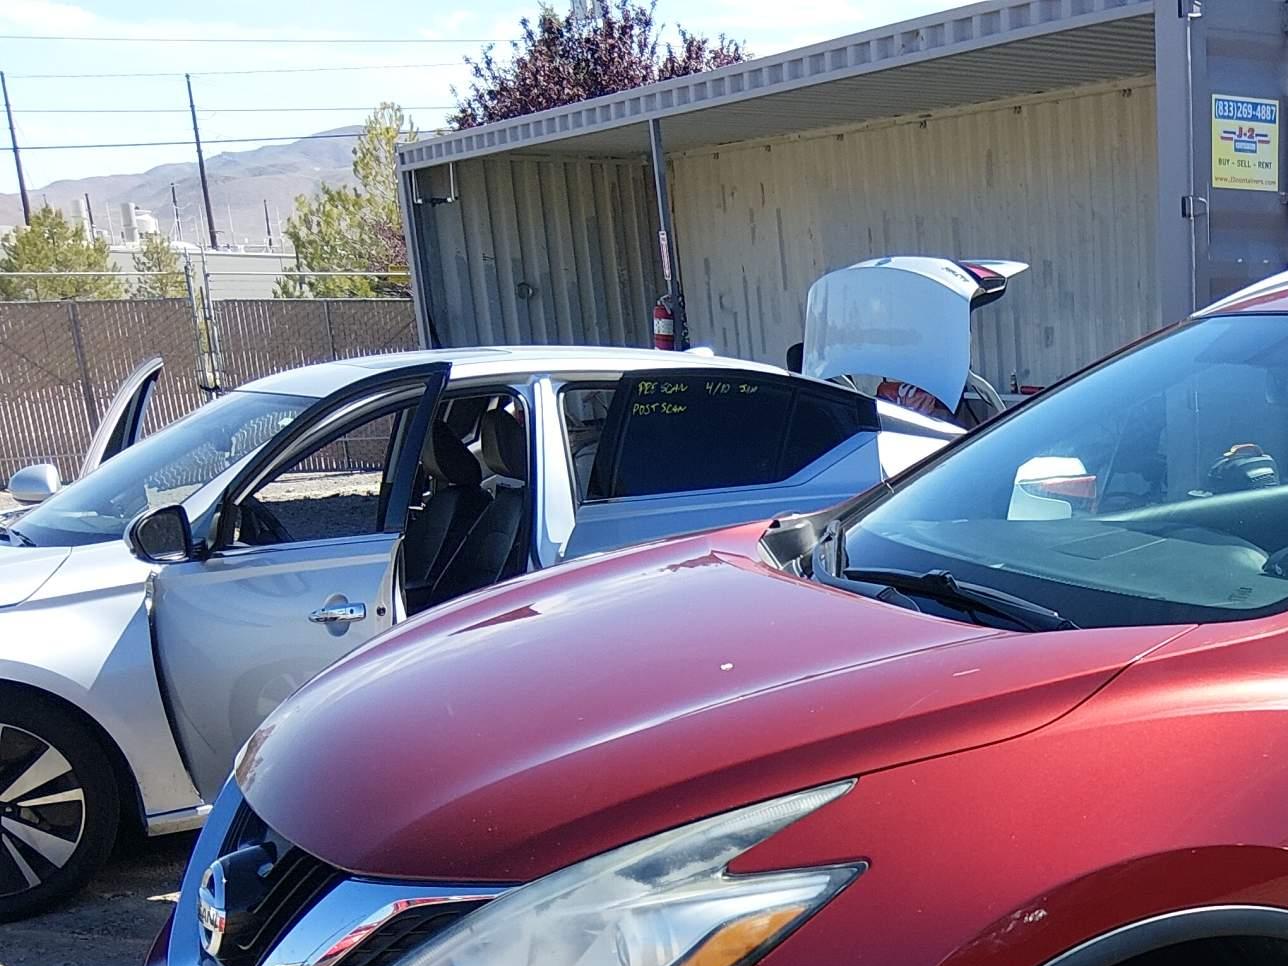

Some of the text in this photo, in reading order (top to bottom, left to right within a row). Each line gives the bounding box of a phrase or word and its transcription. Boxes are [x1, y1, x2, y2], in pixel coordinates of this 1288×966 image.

[1215, 101, 1276, 120] (833)269-4887
[1218, 158, 1230, 166] BUY
[1237, 160, 1251, 168] SELL
[1258, 161, 1272, 169] RENT
[660, 382, 688, 394] SCAN
[632, 402, 688, 416] POST SCAN
